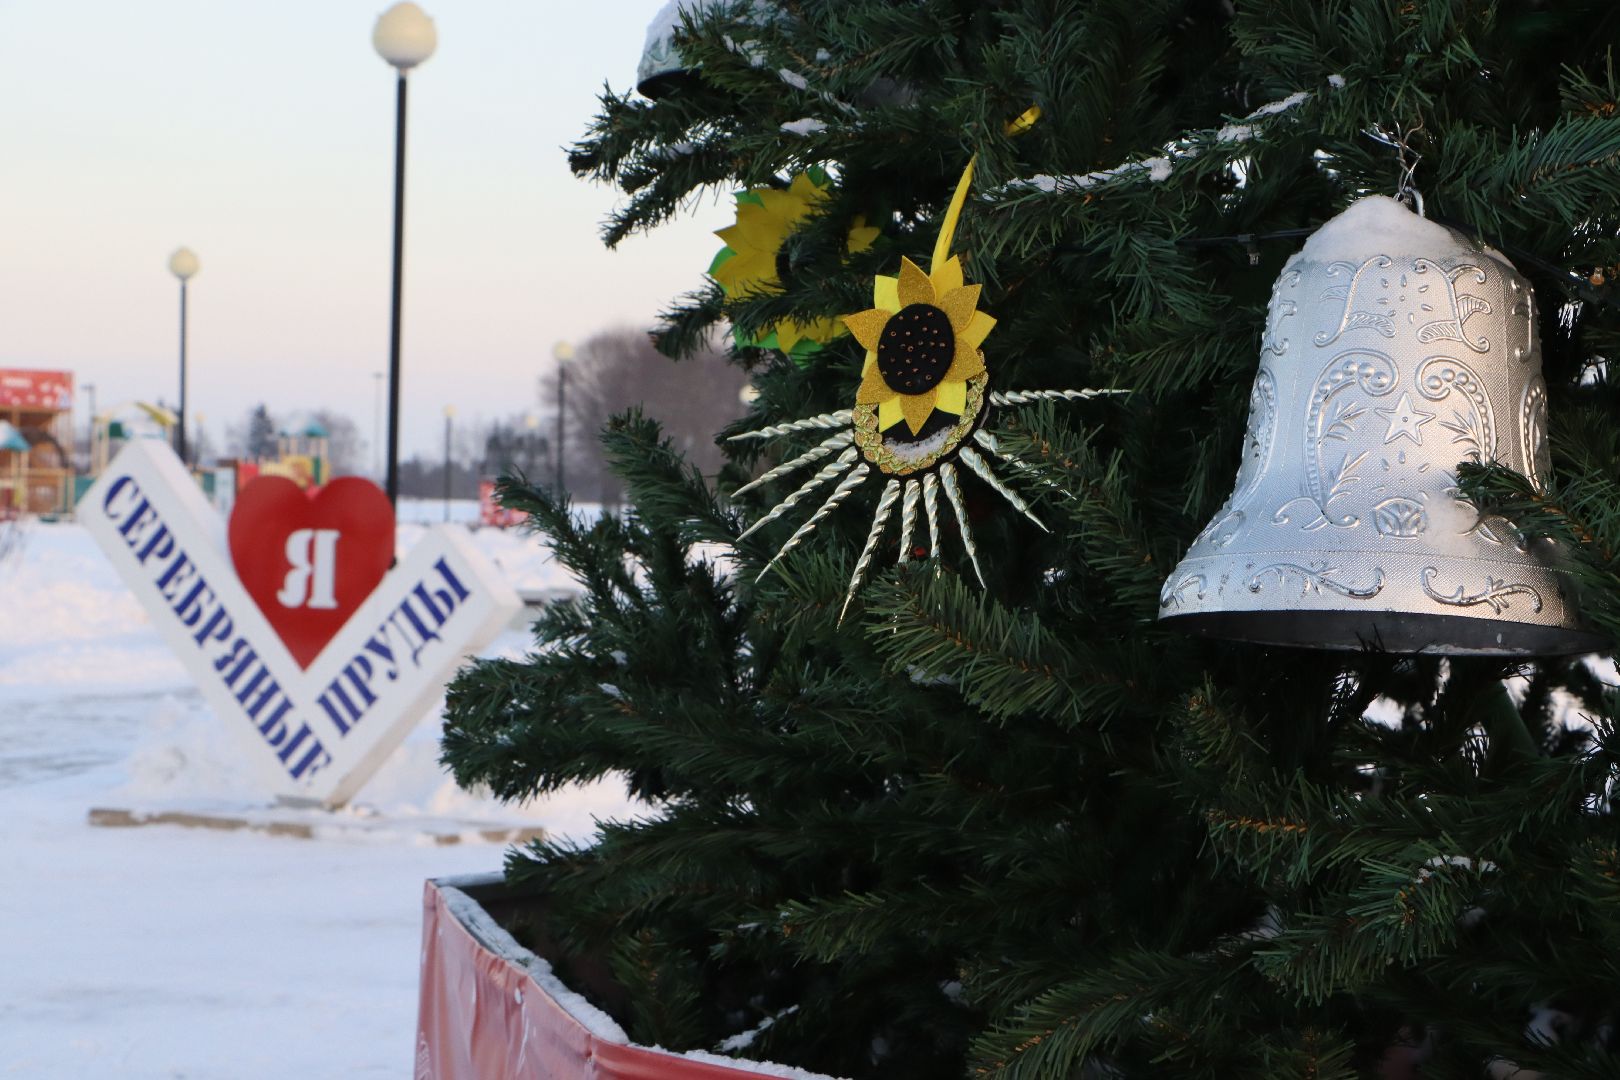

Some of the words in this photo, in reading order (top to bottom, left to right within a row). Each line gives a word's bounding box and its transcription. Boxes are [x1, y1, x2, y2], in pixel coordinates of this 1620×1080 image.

[103, 475, 332, 786] СЕРЕБРЯНЫЕ
[276, 529, 340, 609] Я
[315, 556, 471, 737] ПРУДЫ
